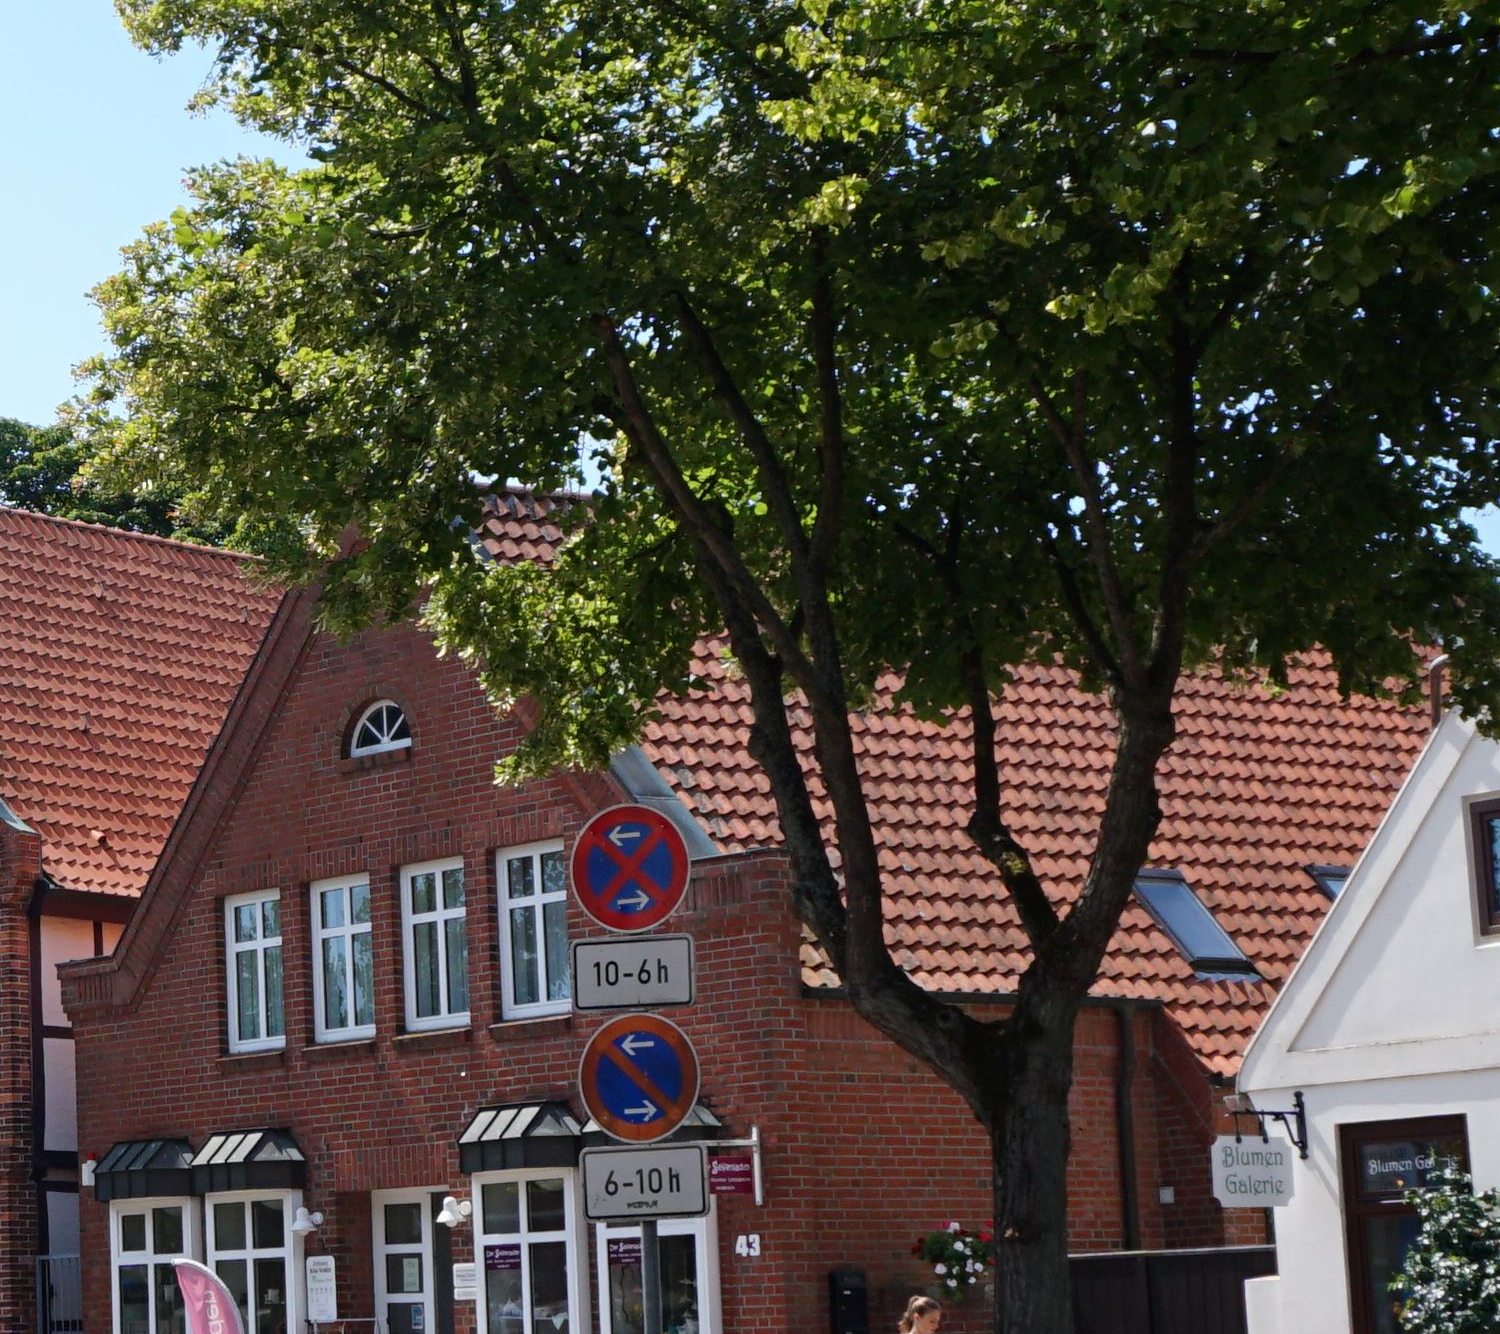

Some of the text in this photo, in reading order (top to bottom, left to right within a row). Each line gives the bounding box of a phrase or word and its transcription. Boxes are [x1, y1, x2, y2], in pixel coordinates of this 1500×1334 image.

[1222, 1145, 1284, 1168] Blumen
[1368, 1158, 1413, 1175] Blumen
[1225, 1172, 1285, 1195] Galerie
[735, 1234, 761, 1257] 43
